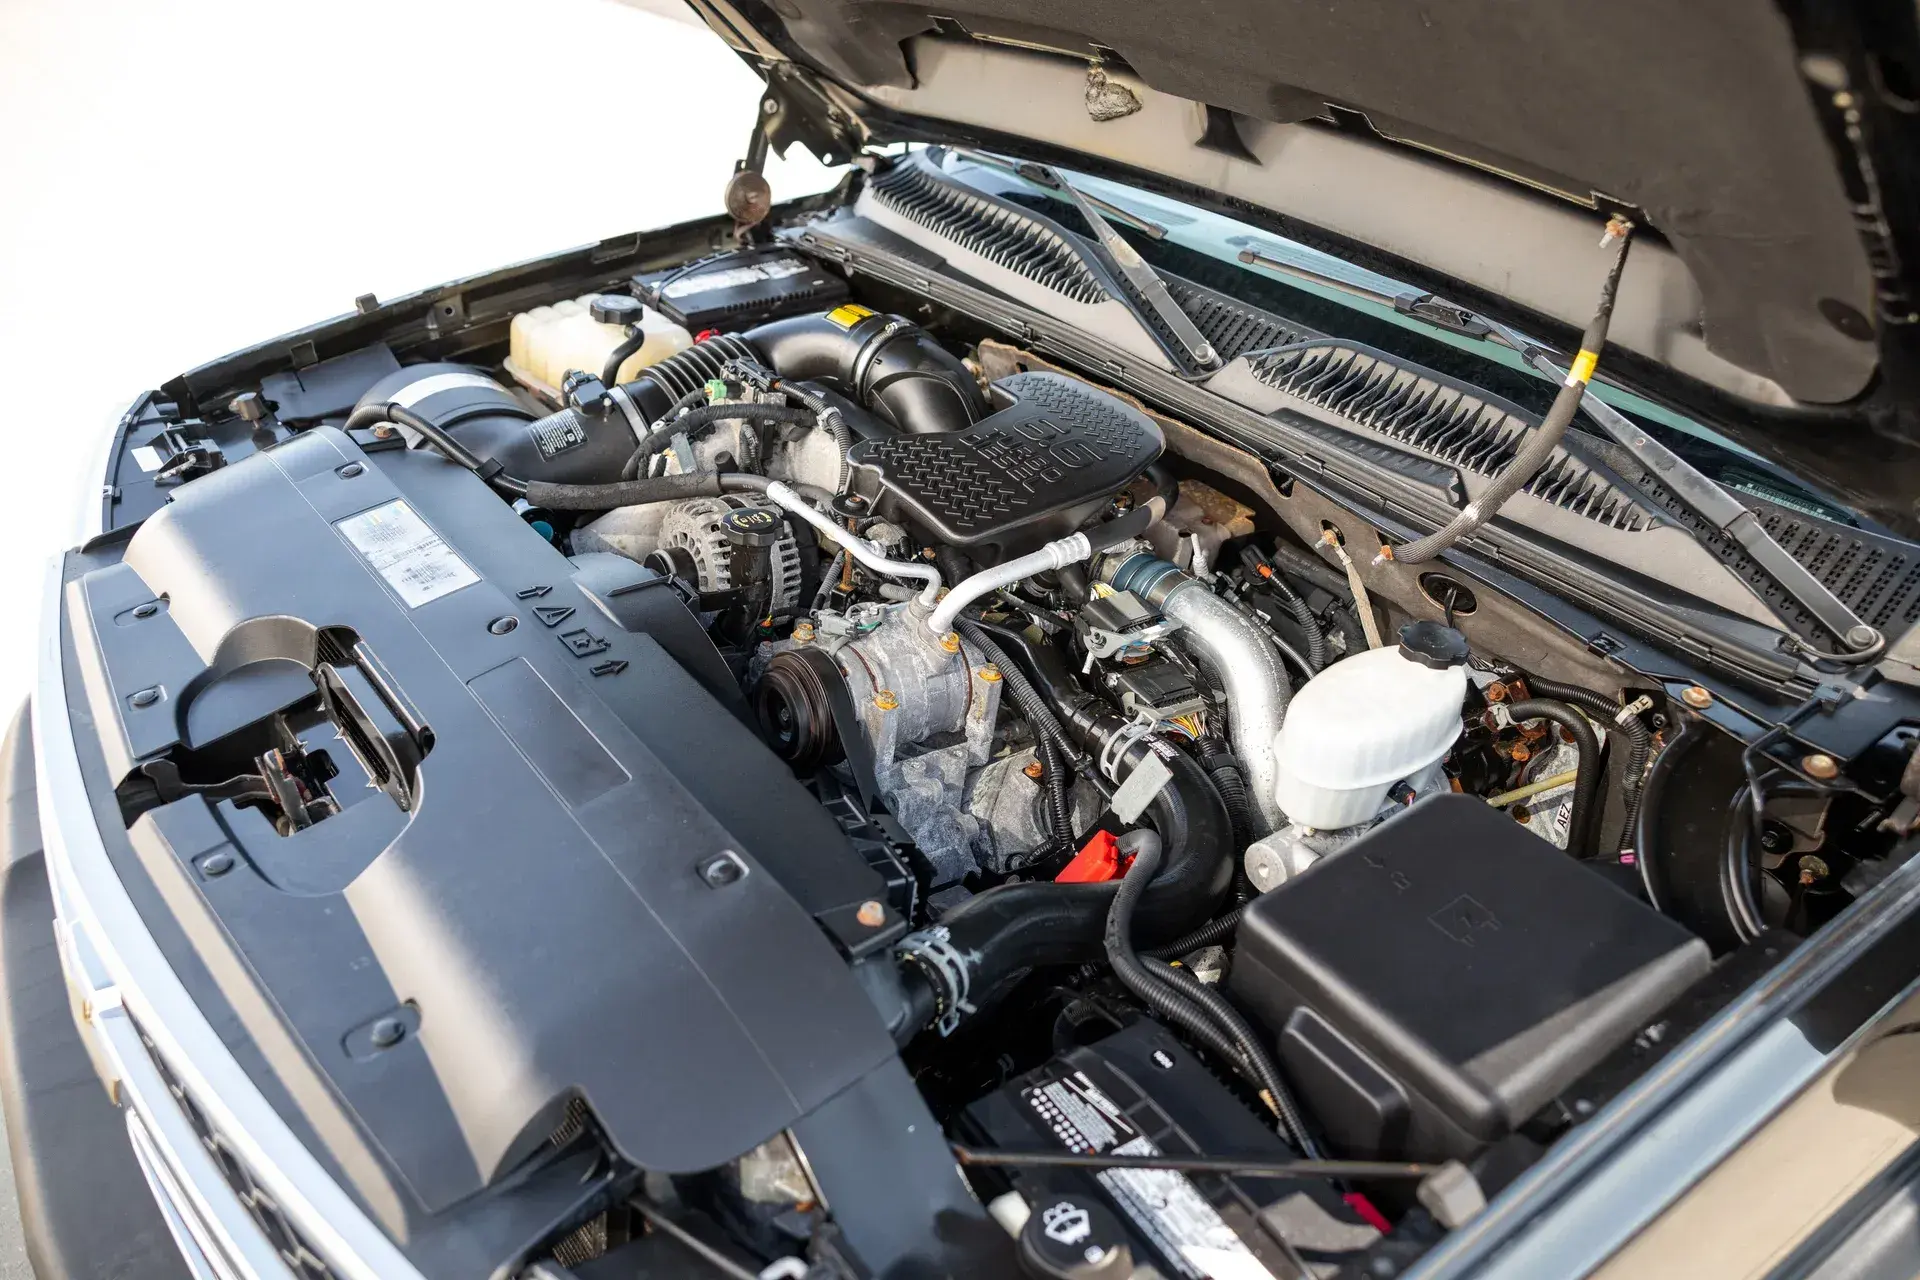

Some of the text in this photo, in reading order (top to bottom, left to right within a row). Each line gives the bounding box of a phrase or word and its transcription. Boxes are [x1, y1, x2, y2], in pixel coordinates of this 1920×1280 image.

[958, 433, 1041, 494] DIESEL
[985, 427, 1066, 483] TURBO
[1013, 416, 1108, 468] 6.6
